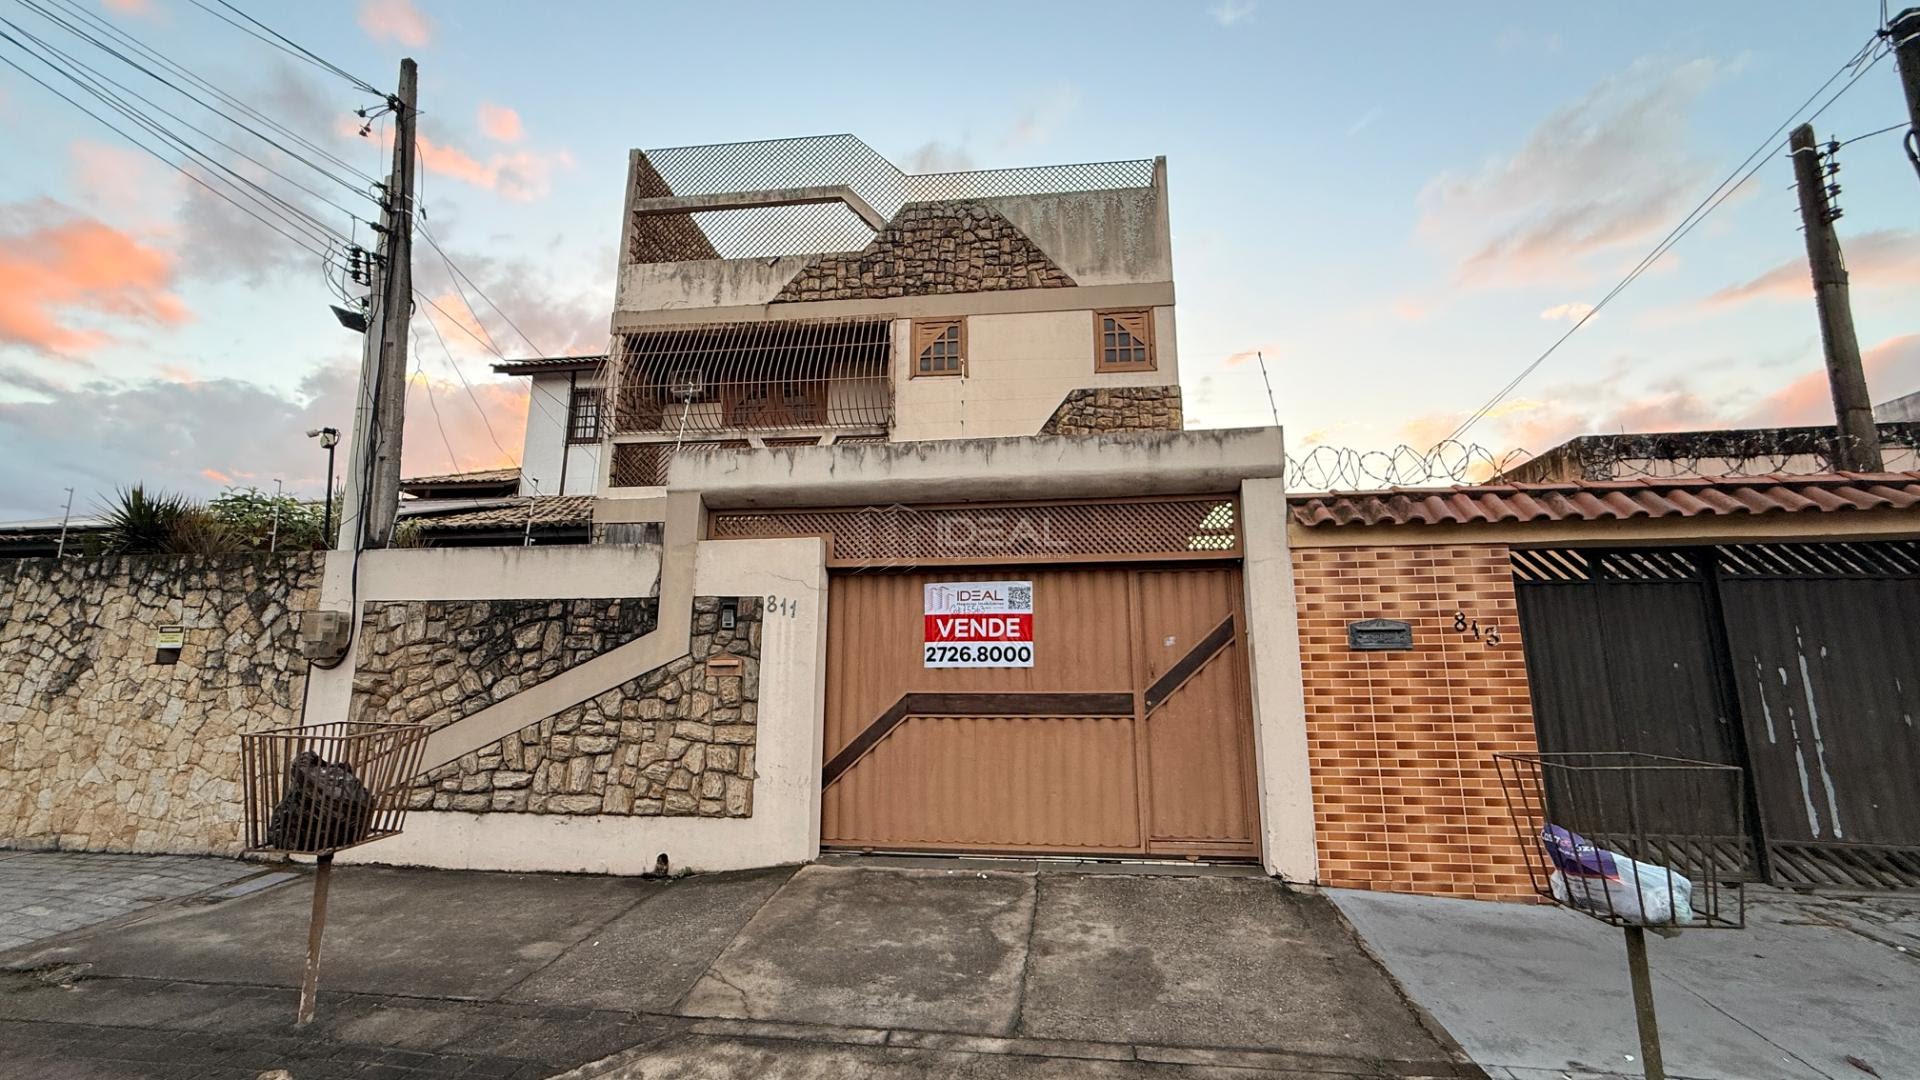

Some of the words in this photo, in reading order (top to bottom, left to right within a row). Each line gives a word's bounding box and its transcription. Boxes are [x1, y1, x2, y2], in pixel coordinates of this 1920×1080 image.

[767, 595, 797, 618] 811
[956, 590, 1004, 602] IDEAL
[936, 617, 1020, 638] VENDE
[1454, 611, 1500, 646] 813
[926, 646, 1031, 662] 2726.8000
